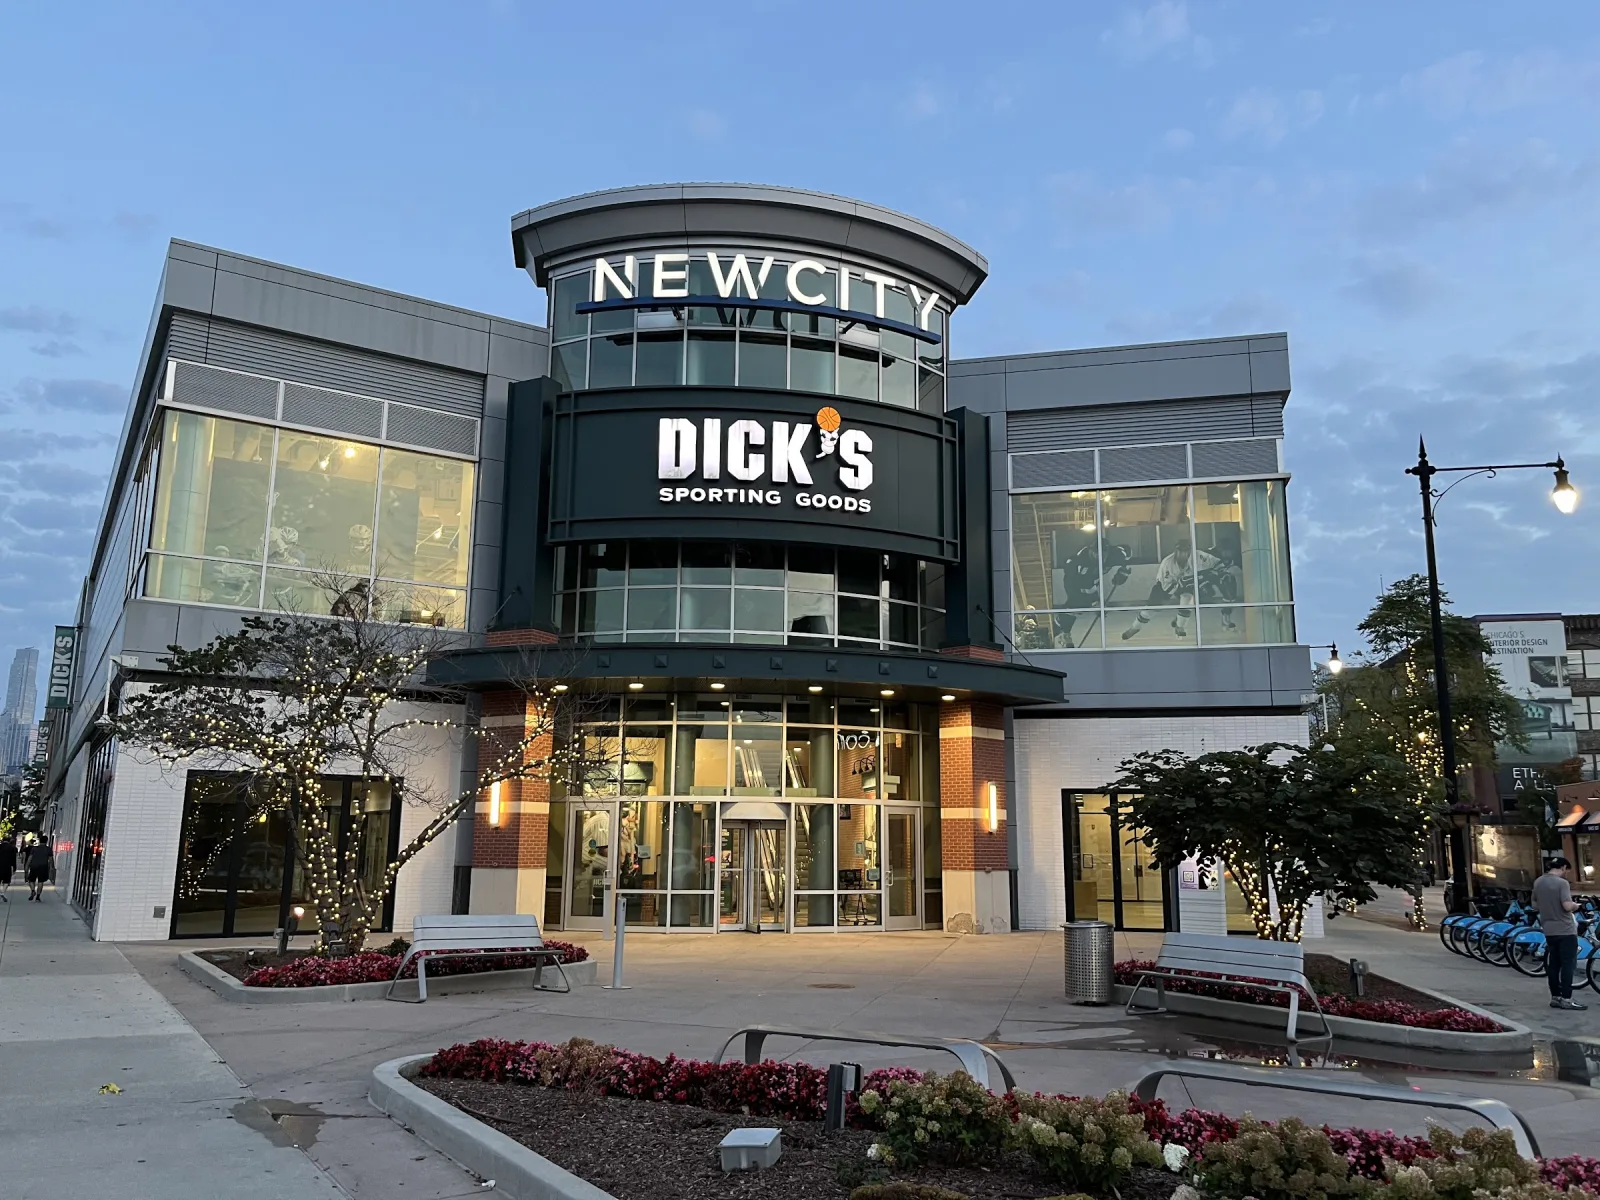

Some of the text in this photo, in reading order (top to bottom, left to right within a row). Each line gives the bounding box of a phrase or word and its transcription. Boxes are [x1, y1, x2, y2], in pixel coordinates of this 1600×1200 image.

[658, 407, 873, 491] DICK'S
[659, 487, 872, 513] SPORTING GOODS
[1521, 638, 1548, 646] DESIGN
[50, 635, 73, 698] DICK'S
